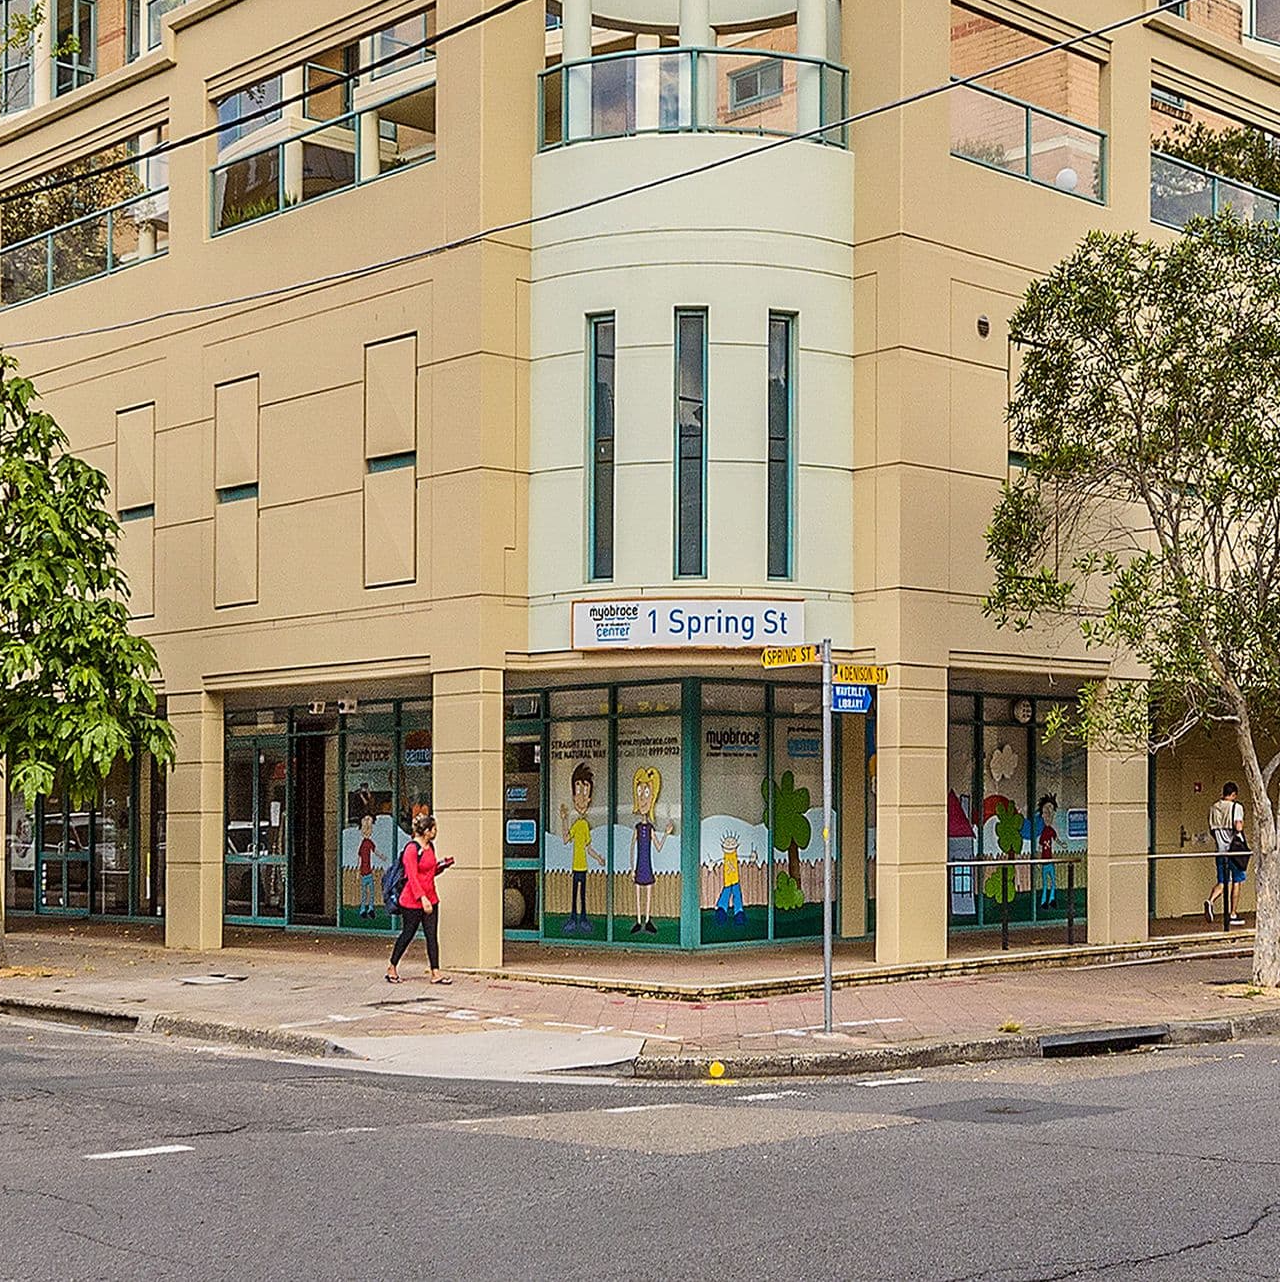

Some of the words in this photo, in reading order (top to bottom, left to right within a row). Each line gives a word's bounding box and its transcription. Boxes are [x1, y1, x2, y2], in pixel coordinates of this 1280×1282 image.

[647, 609, 657, 634] 1
[669, 609, 754, 640] Spring
[763, 609, 788, 634] St
[767, 649, 796, 665] SPRING
[801, 646, 812, 662] ST
[844, 666, 873, 681] DENISON
[877, 668, 885, 683] ST
